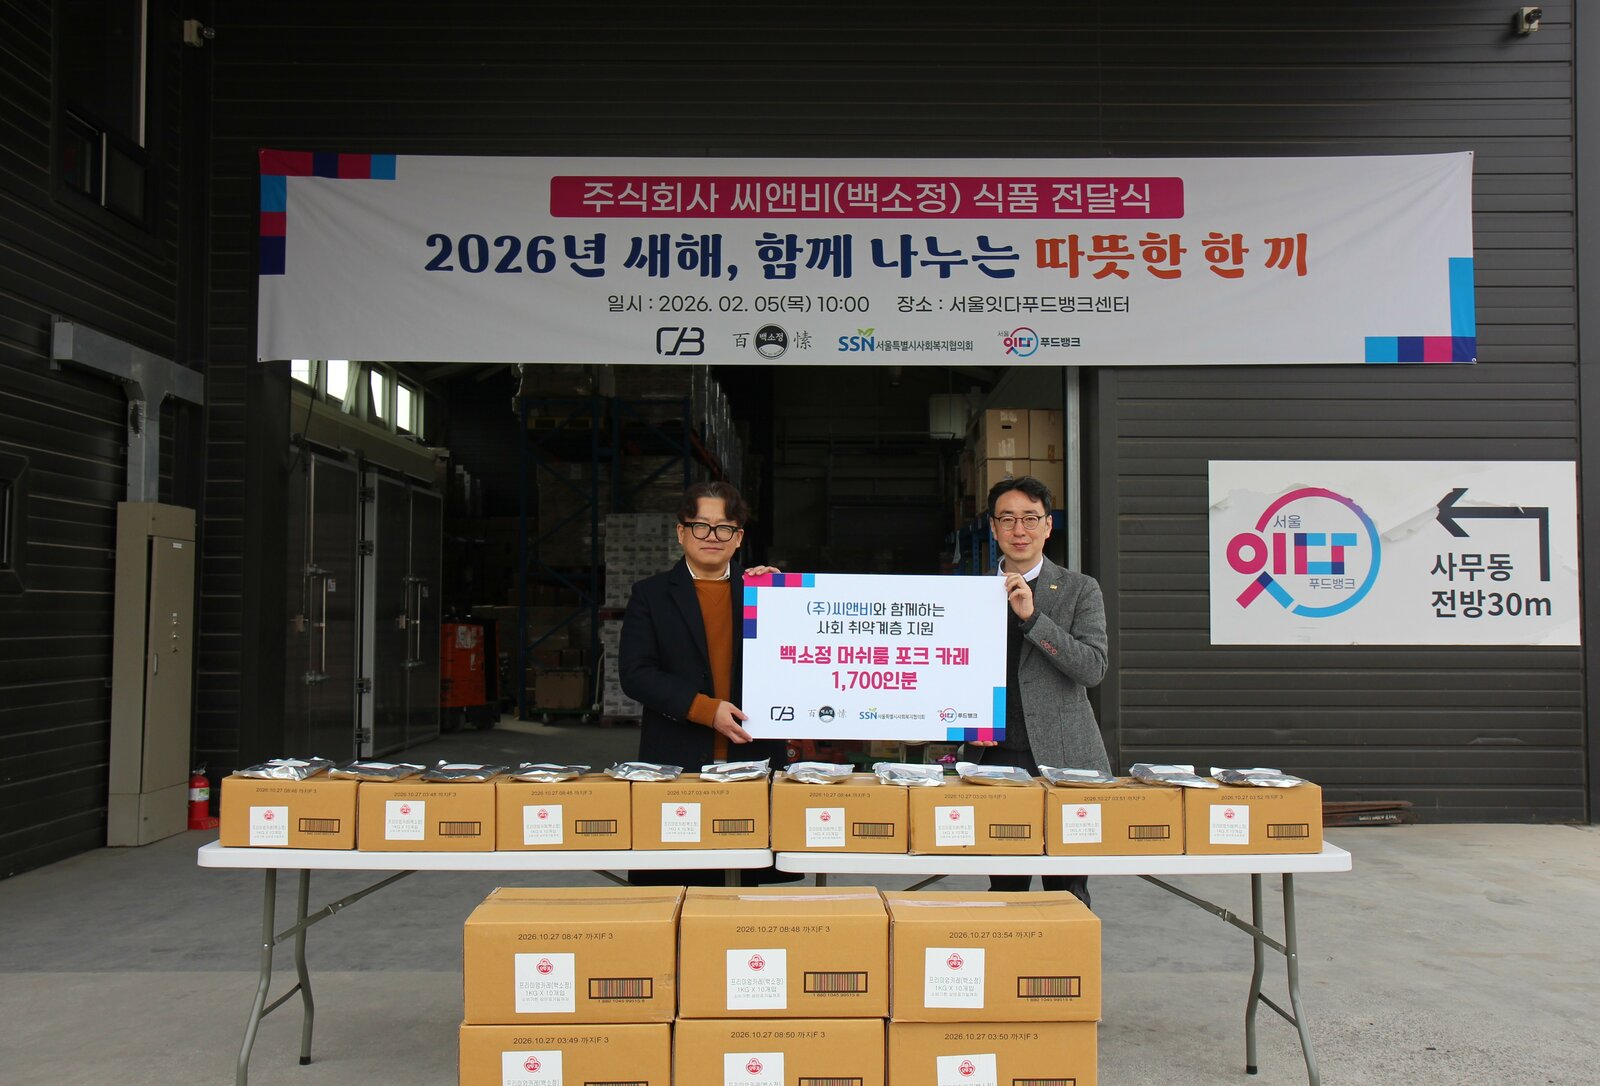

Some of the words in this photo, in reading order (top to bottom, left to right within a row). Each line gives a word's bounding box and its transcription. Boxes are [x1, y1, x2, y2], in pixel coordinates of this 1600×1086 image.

[583, 183, 719, 212] 주식회사
[731, 183, 960, 213] 씨앤비(백소정)
[974, 184, 1038, 213] 식품
[1053, 184, 1150, 213] 전달식
[425, 233, 606, 277] 2026년
[623, 233, 737, 281] 새해,
[755, 232, 852, 279] 함께
[871, 234, 1019, 278] 나누는
[1035, 232, 1187, 279] 따뜻한
[1202, 232, 1249, 278] 한
[1264, 233, 1307, 276] 끼
[608, 295, 641, 312] 일시
[659, 296, 712, 312] 2026.
[719, 296, 747, 311] 02.
[755, 296, 811, 312] 05(목)
[818, 296, 869, 312] 10:00
[898, 296, 932, 312] 장소
[950, 296, 1128, 312] 서울잇다푸드뱅크센터
[732, 332, 750, 349] 百
[759, 331, 784, 342] 백소정
[838, 336, 875, 352] SSN
[876, 340, 973, 352] 서울특별시사회복지협의회
[1040, 337, 1081, 348] 푸드뱅크
[1273, 515, 1301, 529] 서울
[1226, 533, 1357, 609] 잇다
[1431, 553, 1513, 581] 사무동
[1308, 577, 1356, 590] 푸드뱅크
[807, 602, 886, 616] (주)씨앤비와
[891, 602, 944, 617] 함께하는
[1432, 590, 1551, 618] 전방30m
[817, 620, 843, 634] 사회
[849, 621, 902, 635] 취약계층
[907, 622, 933, 635] 지원
[780, 646, 831, 664] 백소정
[838, 647, 889, 665] 머쉬룸
[896, 647, 929, 665] 포크
[936, 648, 969, 665] 카레
[832, 671, 917, 691] 1,700인분
[859, 711, 878, 720] SSN
